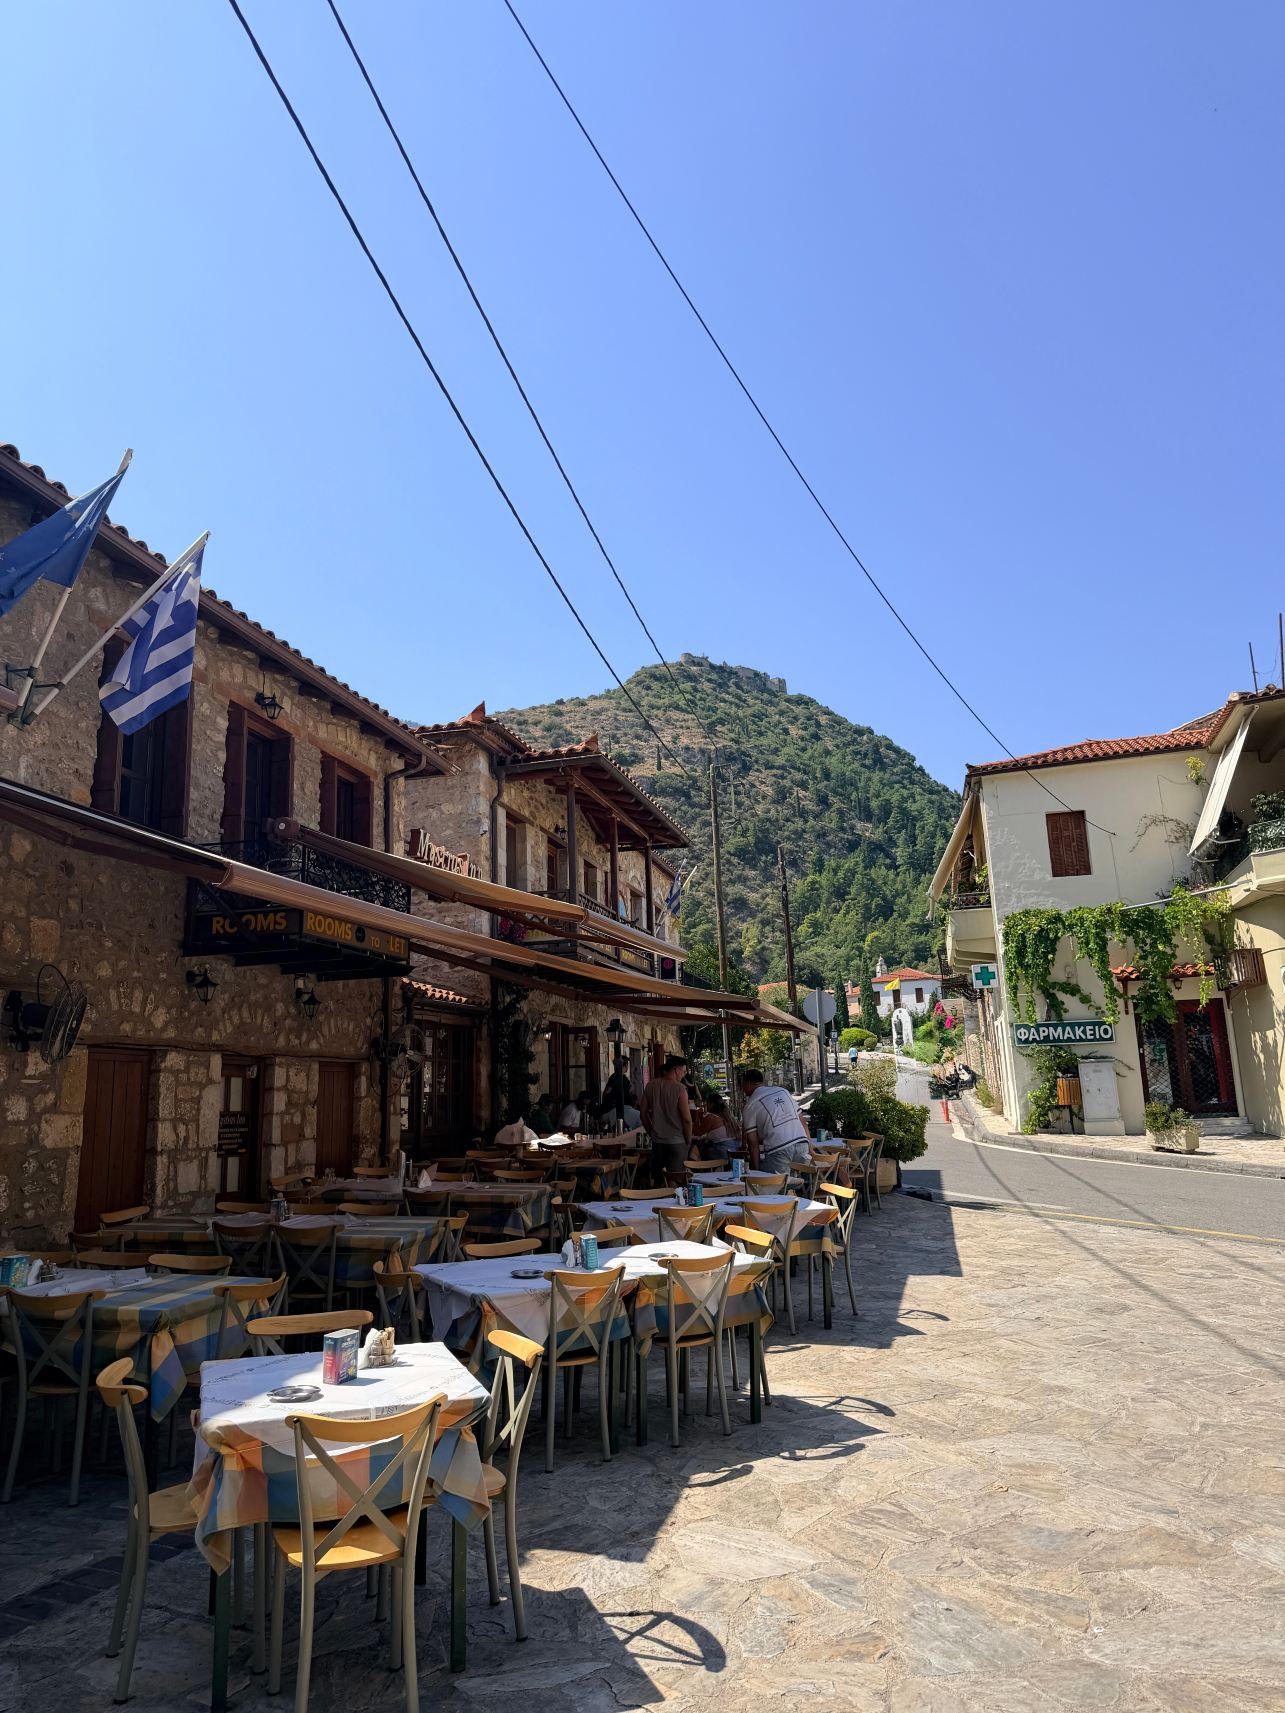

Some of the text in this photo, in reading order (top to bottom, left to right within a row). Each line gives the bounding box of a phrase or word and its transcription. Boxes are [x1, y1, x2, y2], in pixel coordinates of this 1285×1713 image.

[307, 912, 405, 954] ROOMS TO LET
[1016, 1024, 1112, 1041] ΦΑΡΜΑΚΕΙΟ
